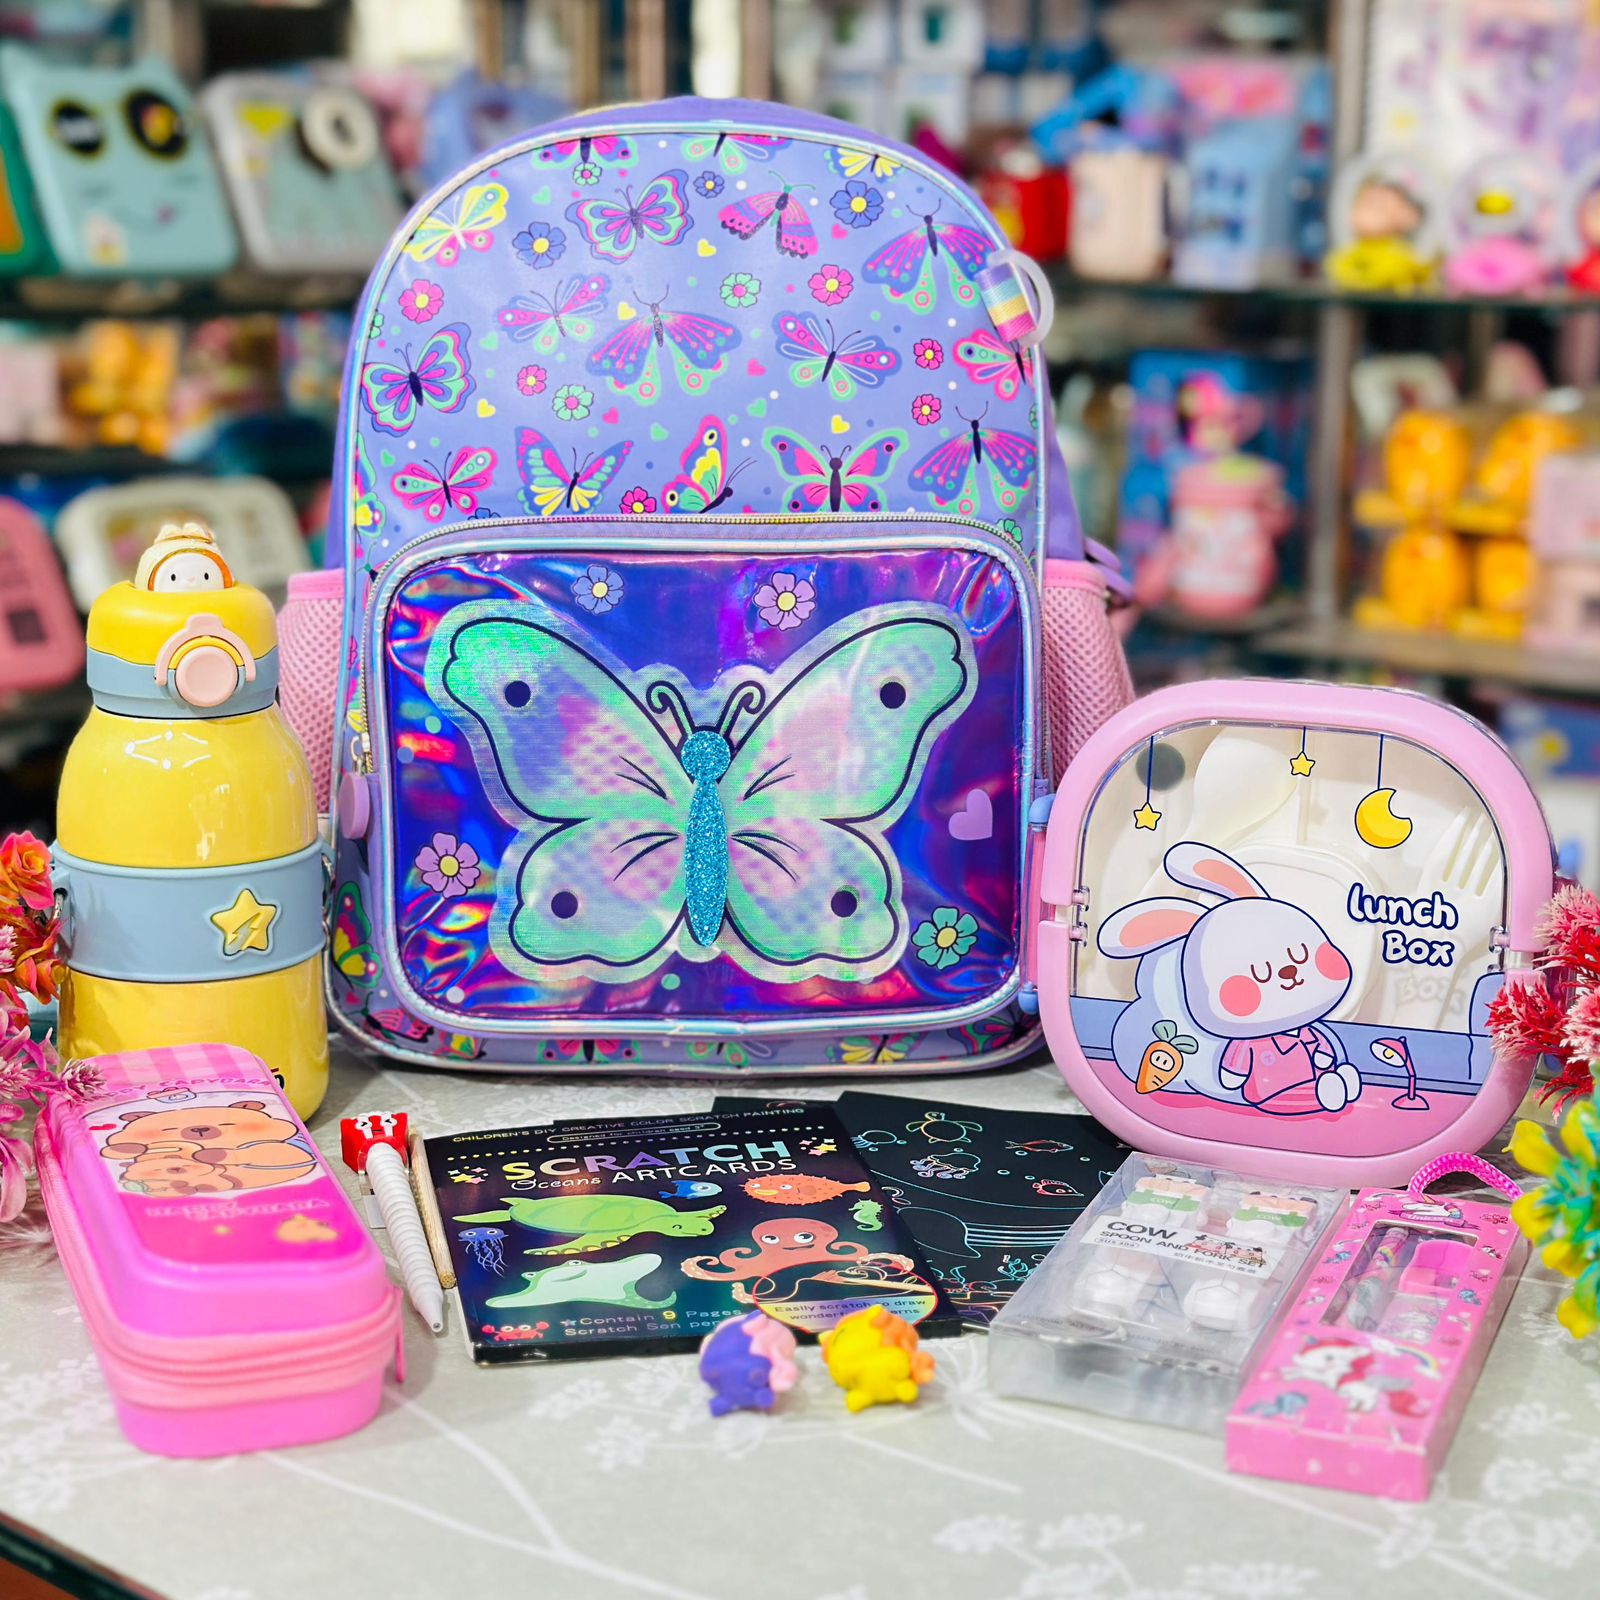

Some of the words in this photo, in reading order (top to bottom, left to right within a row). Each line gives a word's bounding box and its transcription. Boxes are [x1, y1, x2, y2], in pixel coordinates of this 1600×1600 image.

[1347, 882, 1459, 930] lunch
[1382, 929, 1455, 967] Box
[452, 1130, 530, 1143] CHILDREN'S
[534, 1127, 557, 1136] DIY
[561, 1122, 626, 1133] CREATIVE
[630, 1117, 674, 1127] COLOR
[679, 1113, 740, 1123] SCRATCH
[743, 1107, 805, 1118] PAINTING
[501, 1140, 792, 1182] SCRATCH
[510, 1178, 602, 1191] Oceans
[611, 1158, 797, 1184] ARTCARDS
[1100, 1230, 1151, 1244] SPOON
[1156, 1241, 1190, 1252] AND
[1193, 1248, 1232, 1262] FORK
[1107, 1221, 1178, 1240] COW
[579, 1314, 655, 1326] Contain
[662, 1310, 677, 1321] 9
[685, 1309, 742, 1318] Pages
[774, 1305, 815, 1313] Easily
[819, 1302, 871, 1310] scratch
[893, 1299, 926, 1307] draw
[564, 1324, 638, 1337] Scratch
